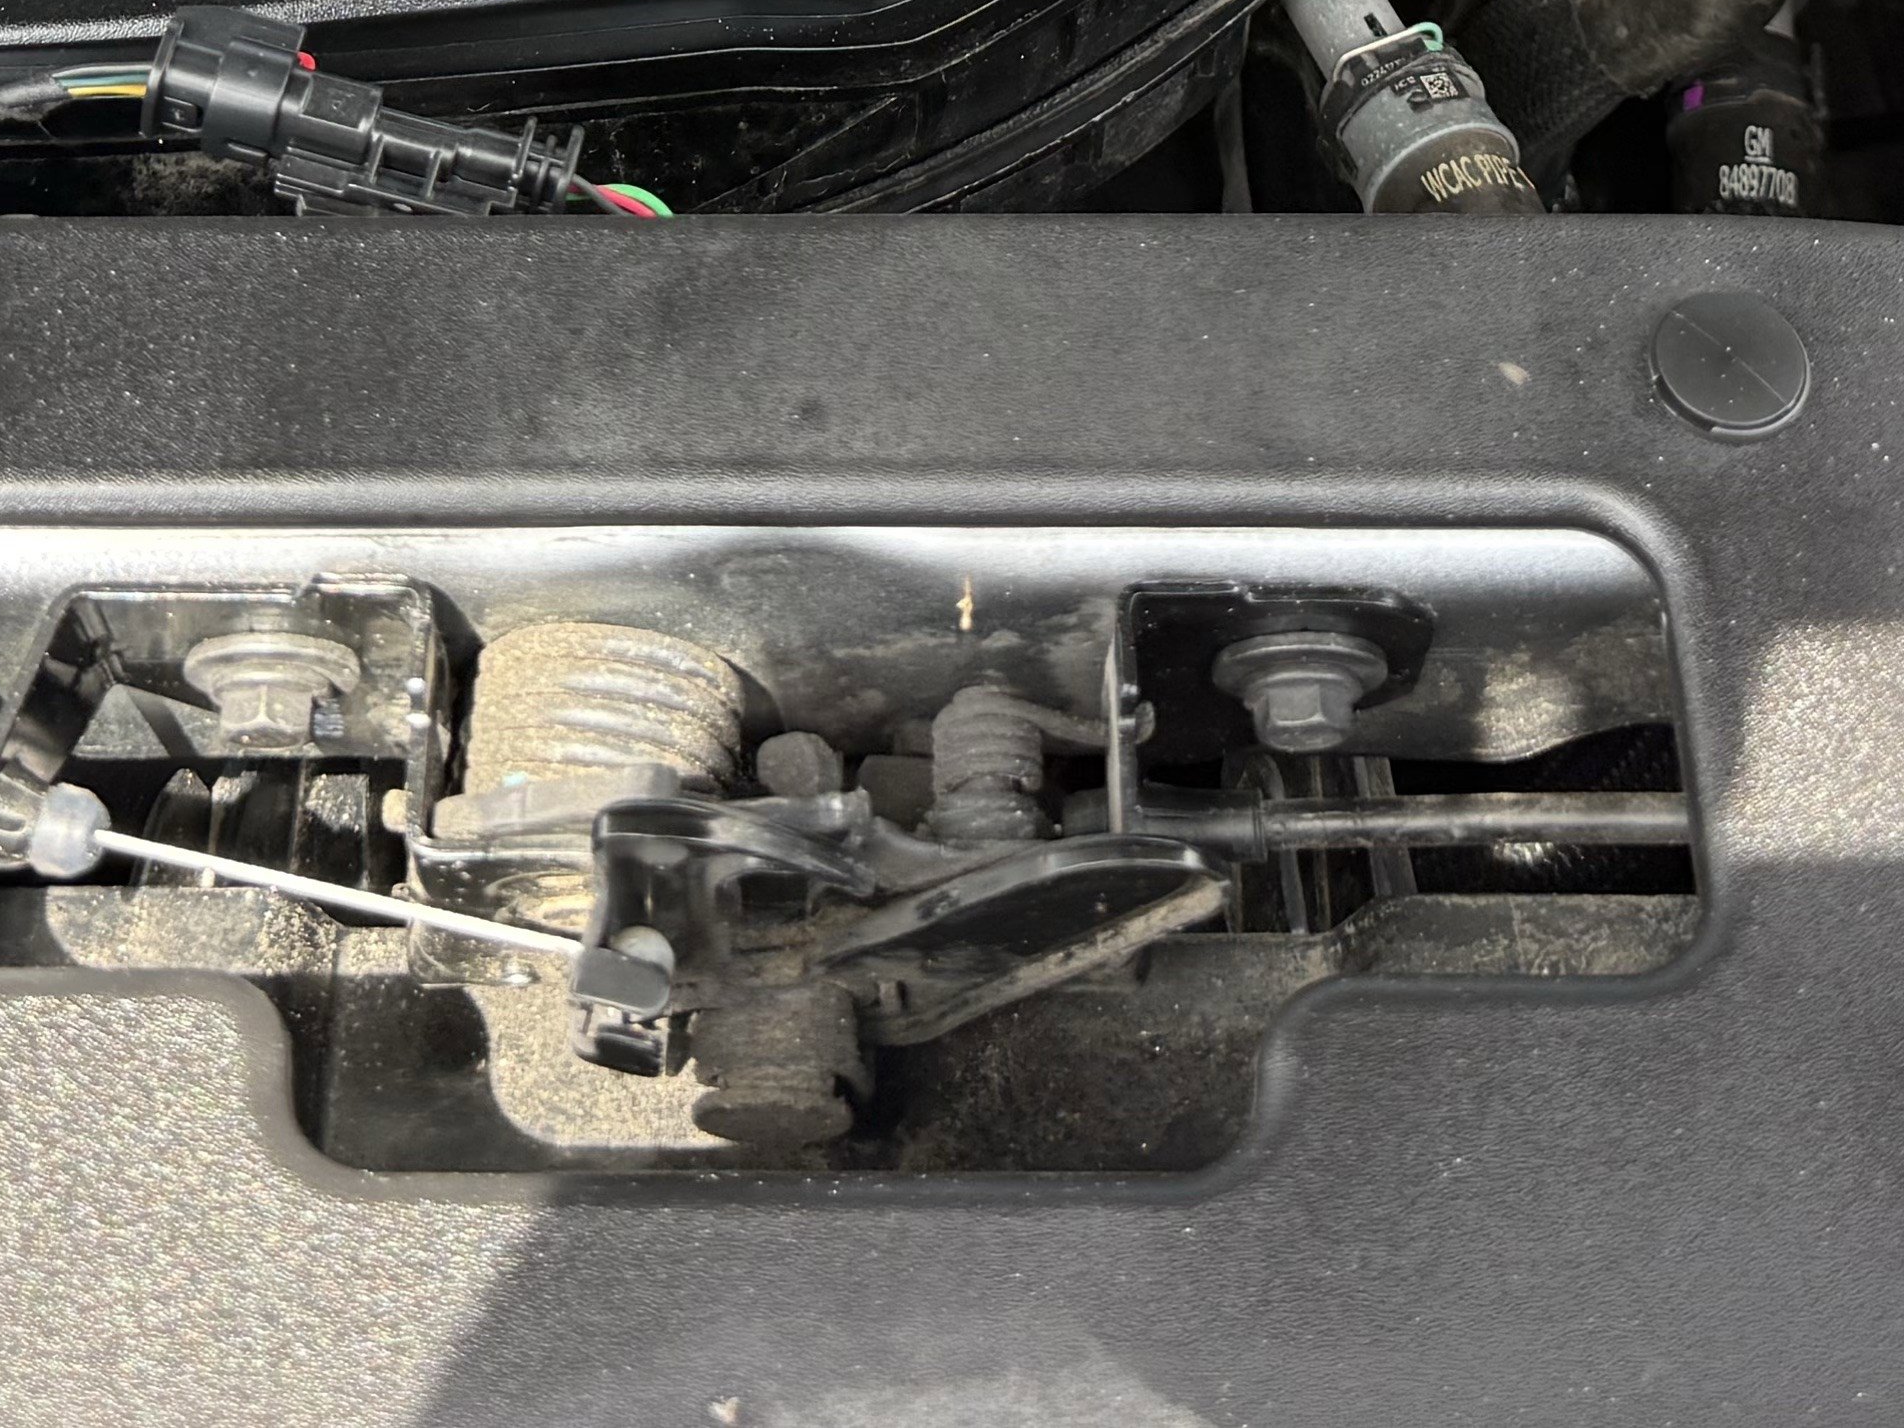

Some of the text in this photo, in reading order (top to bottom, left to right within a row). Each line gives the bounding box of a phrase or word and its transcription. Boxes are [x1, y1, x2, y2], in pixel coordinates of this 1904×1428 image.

[1744, 125, 1774, 157] GM
[1421, 155, 1482, 203] WCAC
[1473, 153, 1525, 192] PIPE
[1718, 164, 1799, 206] 84897708
